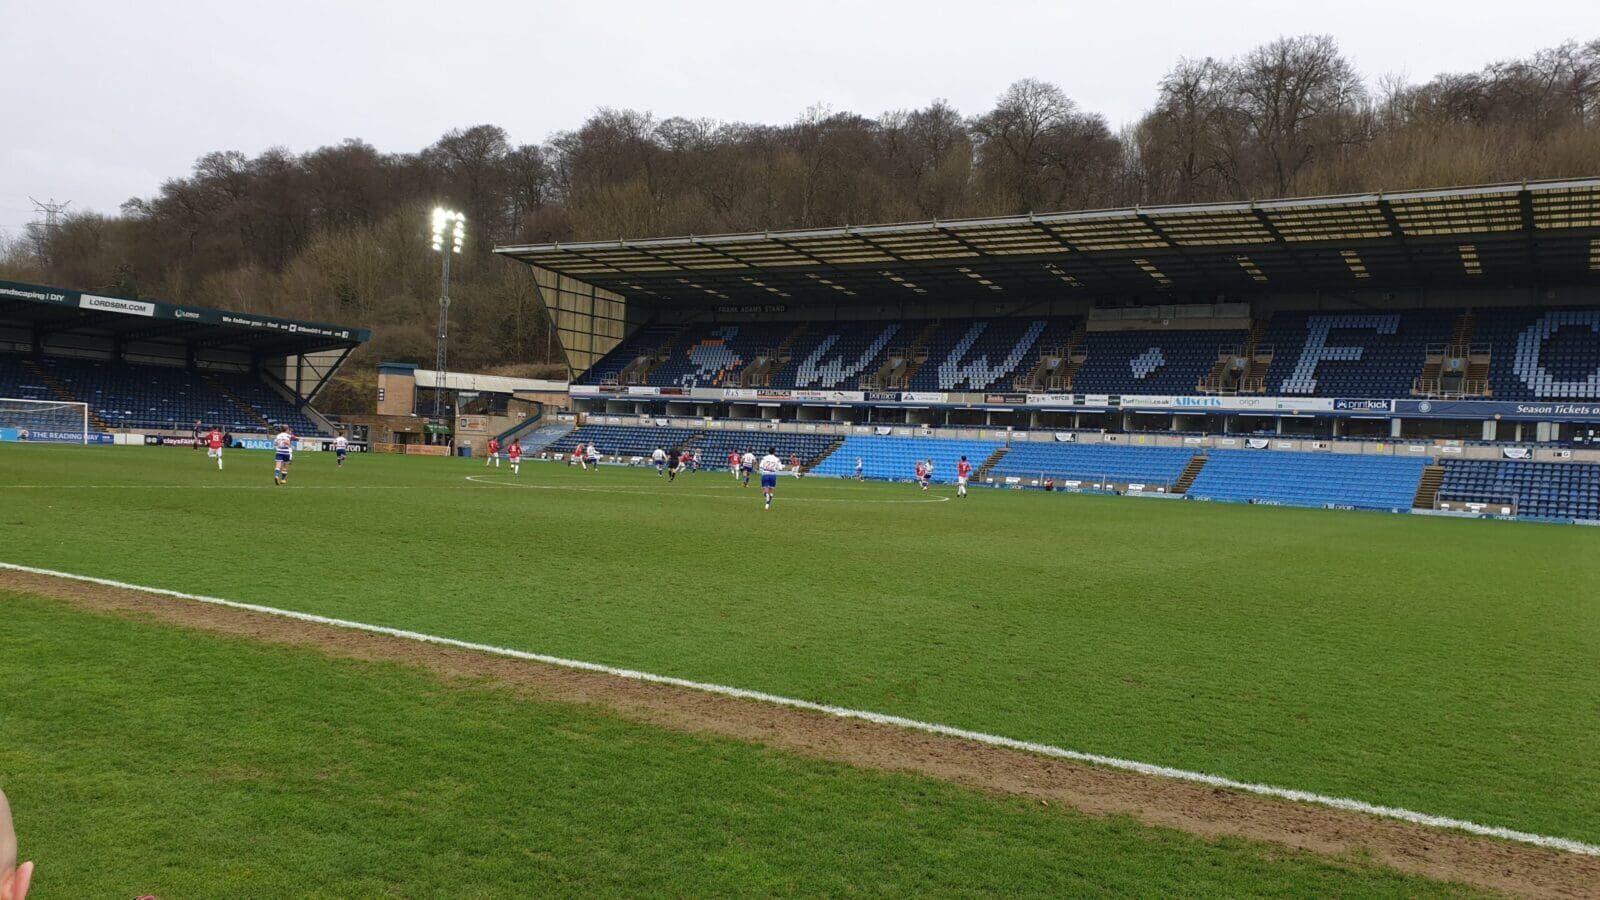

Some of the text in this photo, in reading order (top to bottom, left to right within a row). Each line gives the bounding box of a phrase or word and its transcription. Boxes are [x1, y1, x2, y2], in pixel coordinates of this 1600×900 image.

[50, 293, 65, 302] DIY
[89, 299, 146, 312] LORDSBM.COM
[232, 317, 250, 325] follow
[1348, 400, 1388, 410] printkick
[1517, 404, 1552, 413] Season
[1554, 405, 1590, 414] Tickets
[33, 431, 49, 439] THE
[49, 432, 83, 440] READING
